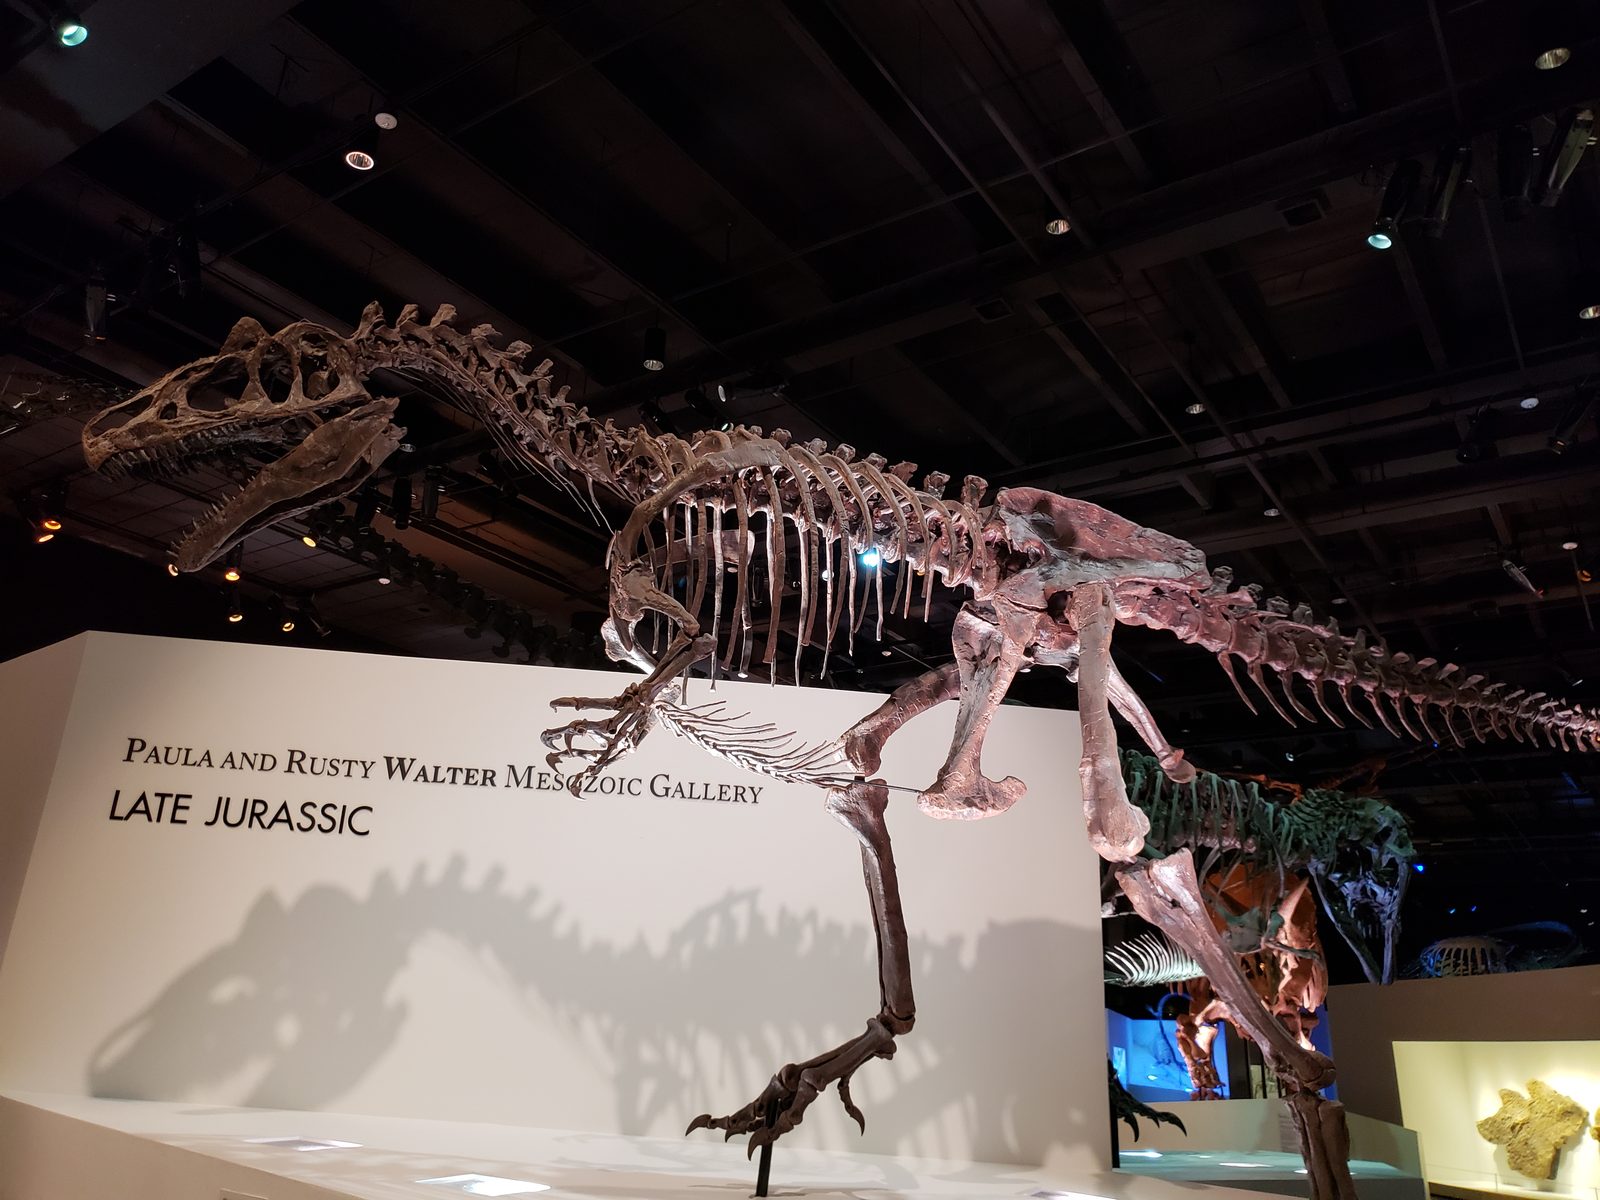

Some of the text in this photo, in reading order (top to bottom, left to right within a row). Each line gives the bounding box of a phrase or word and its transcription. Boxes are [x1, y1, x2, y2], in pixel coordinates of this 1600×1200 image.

[123, 737, 214, 768] PAULA
[220, 751, 277, 772] AND
[284, 749, 376, 779] RUSTY
[383, 755, 497, 787] WALTER
[650, 774, 764, 804] GALLERY
[109, 790, 373, 836] LATE JURASSIC
